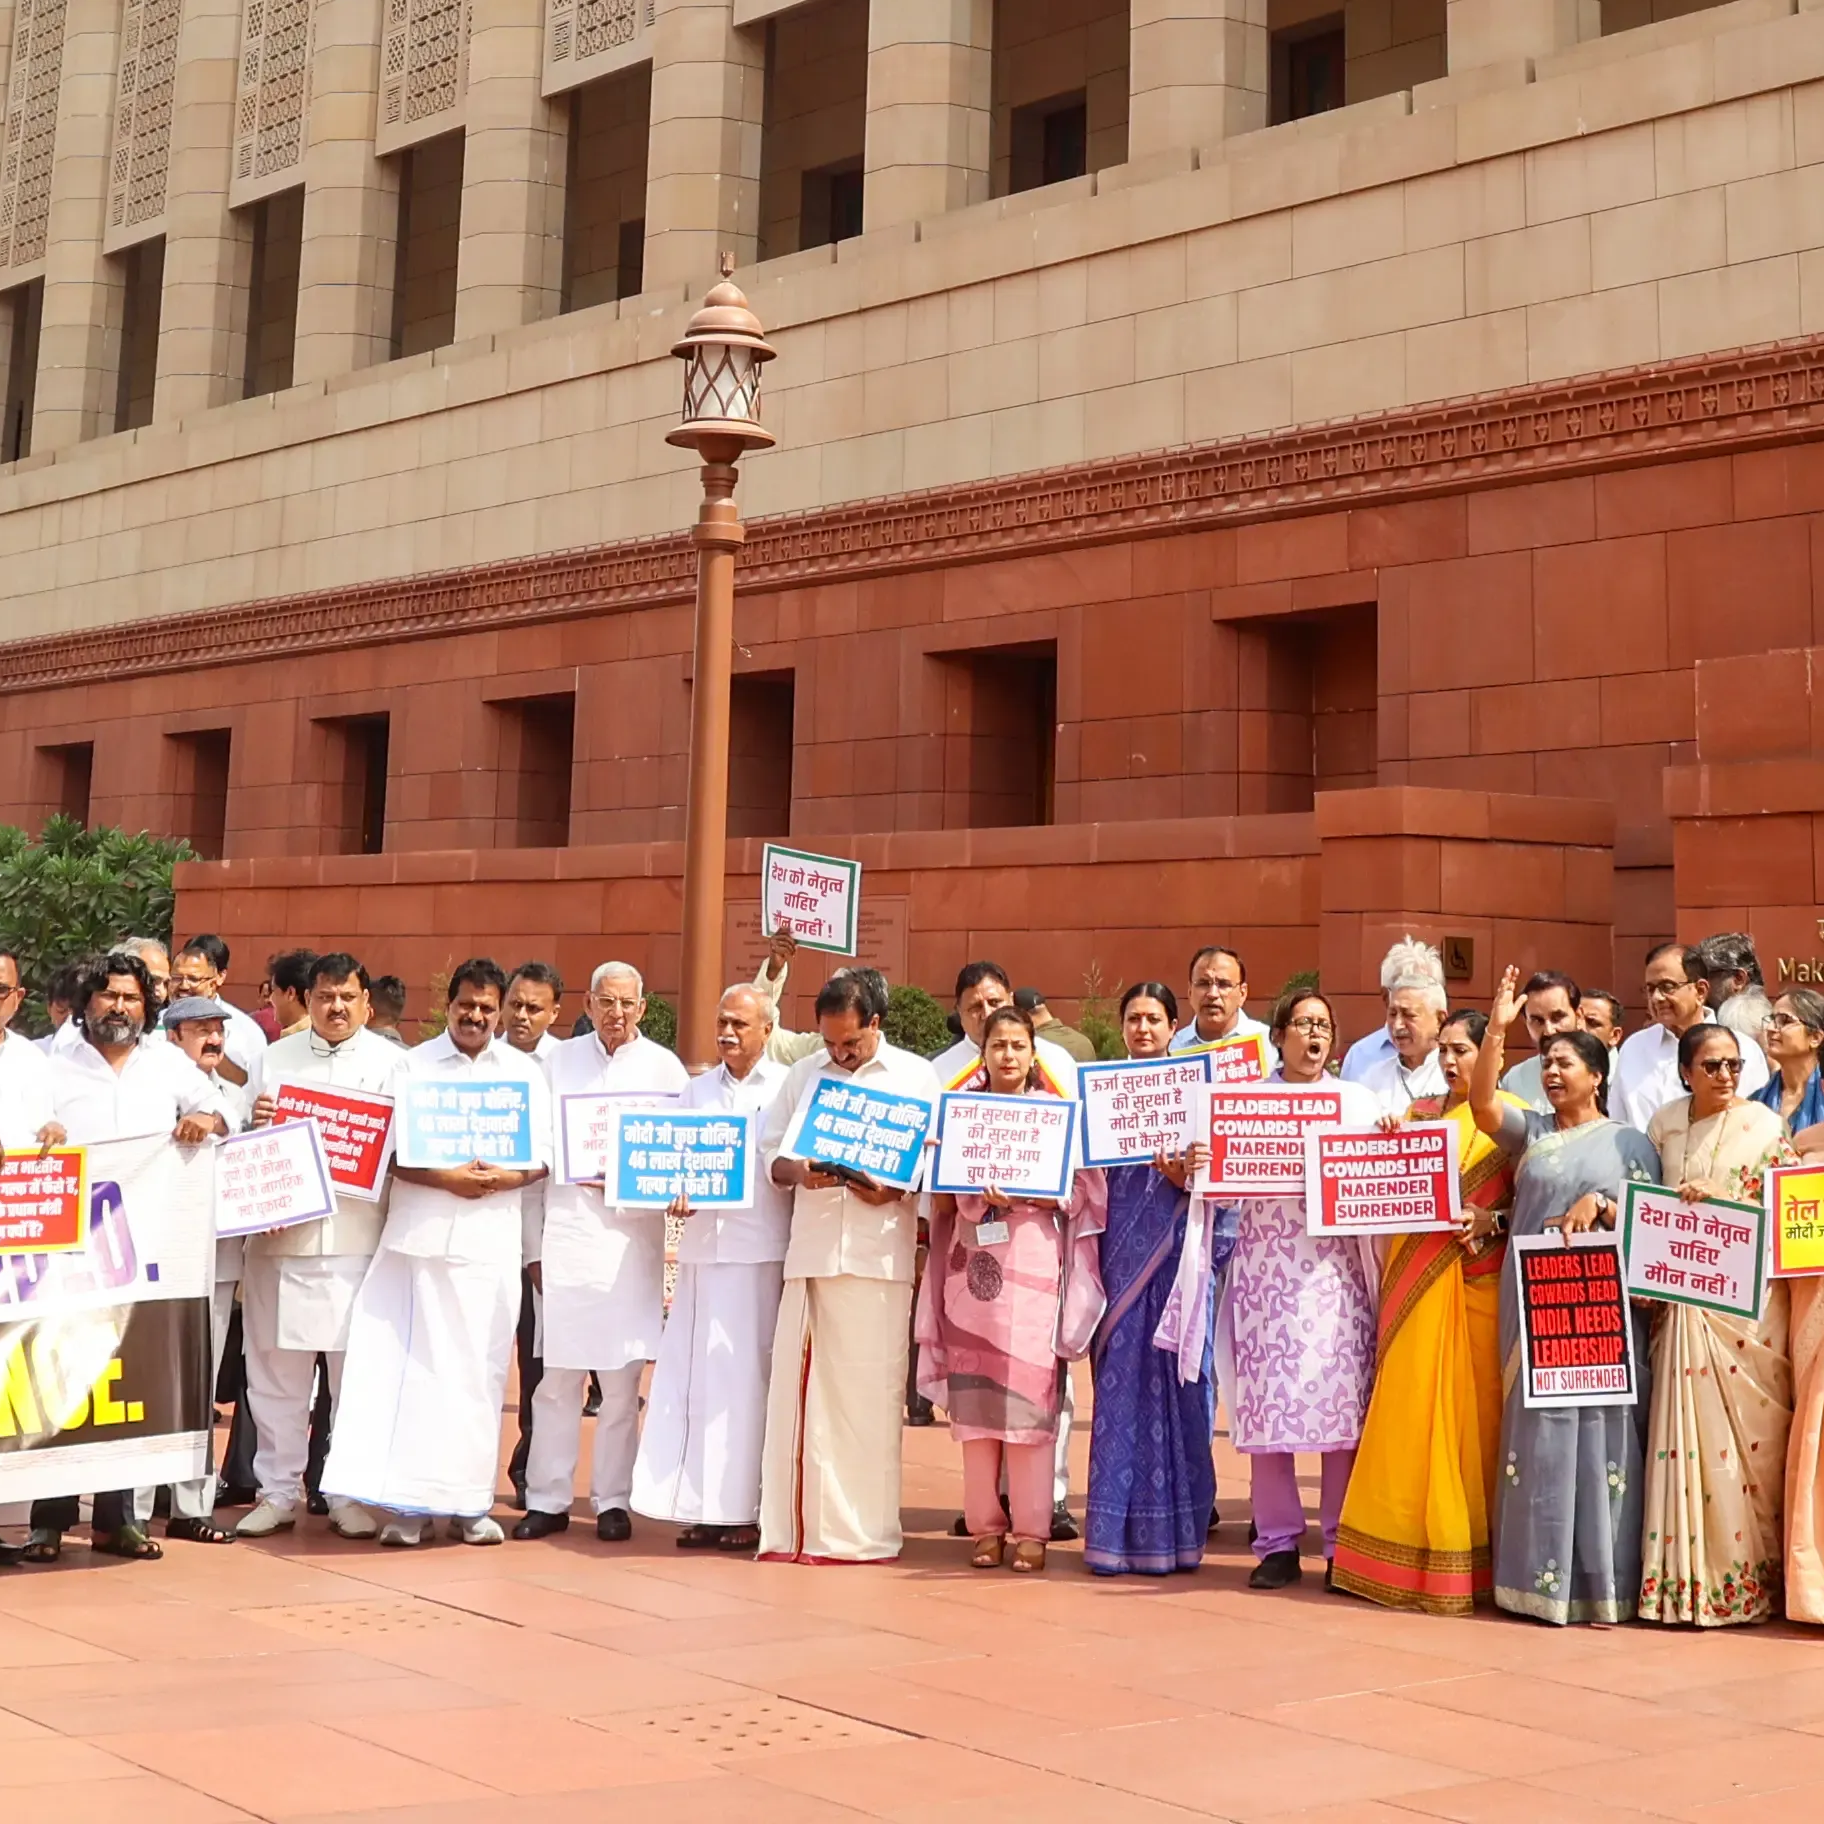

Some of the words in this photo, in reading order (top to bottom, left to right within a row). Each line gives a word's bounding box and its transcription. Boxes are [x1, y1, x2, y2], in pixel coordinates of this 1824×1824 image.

[772, 862, 787, 881] देश
[789, 868, 804, 886] को
[807, 871, 844, 897] नेतृत्व
[784, 891, 818, 913] चाहिए
[796, 917, 825, 937] नहीं
[1091, 1073, 1119, 1092] ऊर्जा
[1122, 1074, 1161, 1093] सुरक्षा
[1163, 1068, 1177, 1085] ही
[1179, 1068, 1201, 1083] देश
[1112, 1093, 1129, 1110] की
[1133, 1093, 1170, 1113] सुरक्षा
[1174, 1088, 1182, 1104] है
[1214, 1100, 1290, 1115] LEADERS
[1293, 1099, 1337, 1115] LEAD
[1109, 1112, 1140, 1130] मोदी
[1143, 1111, 1159, 1127] जी
[1164, 1110, 1187, 1125] आप
[1213, 1120, 1298, 1136] COWARDS
[1118, 1137, 1137, 1155] चुप
[1323, 1138, 1399, 1156] LEADERS
[1401, 1136, 1443, 1153] LEAD
[629, 1150, 645, 1170] 46
[1323, 1160, 1407, 1177] COWARDS
[1409, 1157, 1444, 1173] LIKE
[1341, 1179, 1428, 1198] NARENDER
[1337, 1200, 1433, 1218] SURRENDER
[1785, 1195, 1819, 1222] तेल
[1640, 1202, 1672, 1227] देश
[1674, 1210, 1700, 1233] को
[1703, 1216, 1751, 1247] नेतृत्व
[1785, 1223, 1814, 1240] मोदी
[1669, 1240, 1720, 1266] चाहिए
[1527, 1255, 1581, 1279] LEADERS
[1583, 1253, 1615, 1276] LEAD
[1644, 1261, 1686, 1287] मौन
[1688, 1274, 1730, 1296] नहीं
[1530, 1282, 1585, 1305] COWARDS
[1588, 1280, 1618, 1301] HEAD
[1531, 1307, 1571, 1336] INDIA
[1575, 1305, 1621, 1334] NEEDS
[1533, 1336, 1623, 1367] LEADERSHIP
[1536, 1371, 1557, 1391] NOT
[1561, 1368, 1624, 1390] SURRENDER
